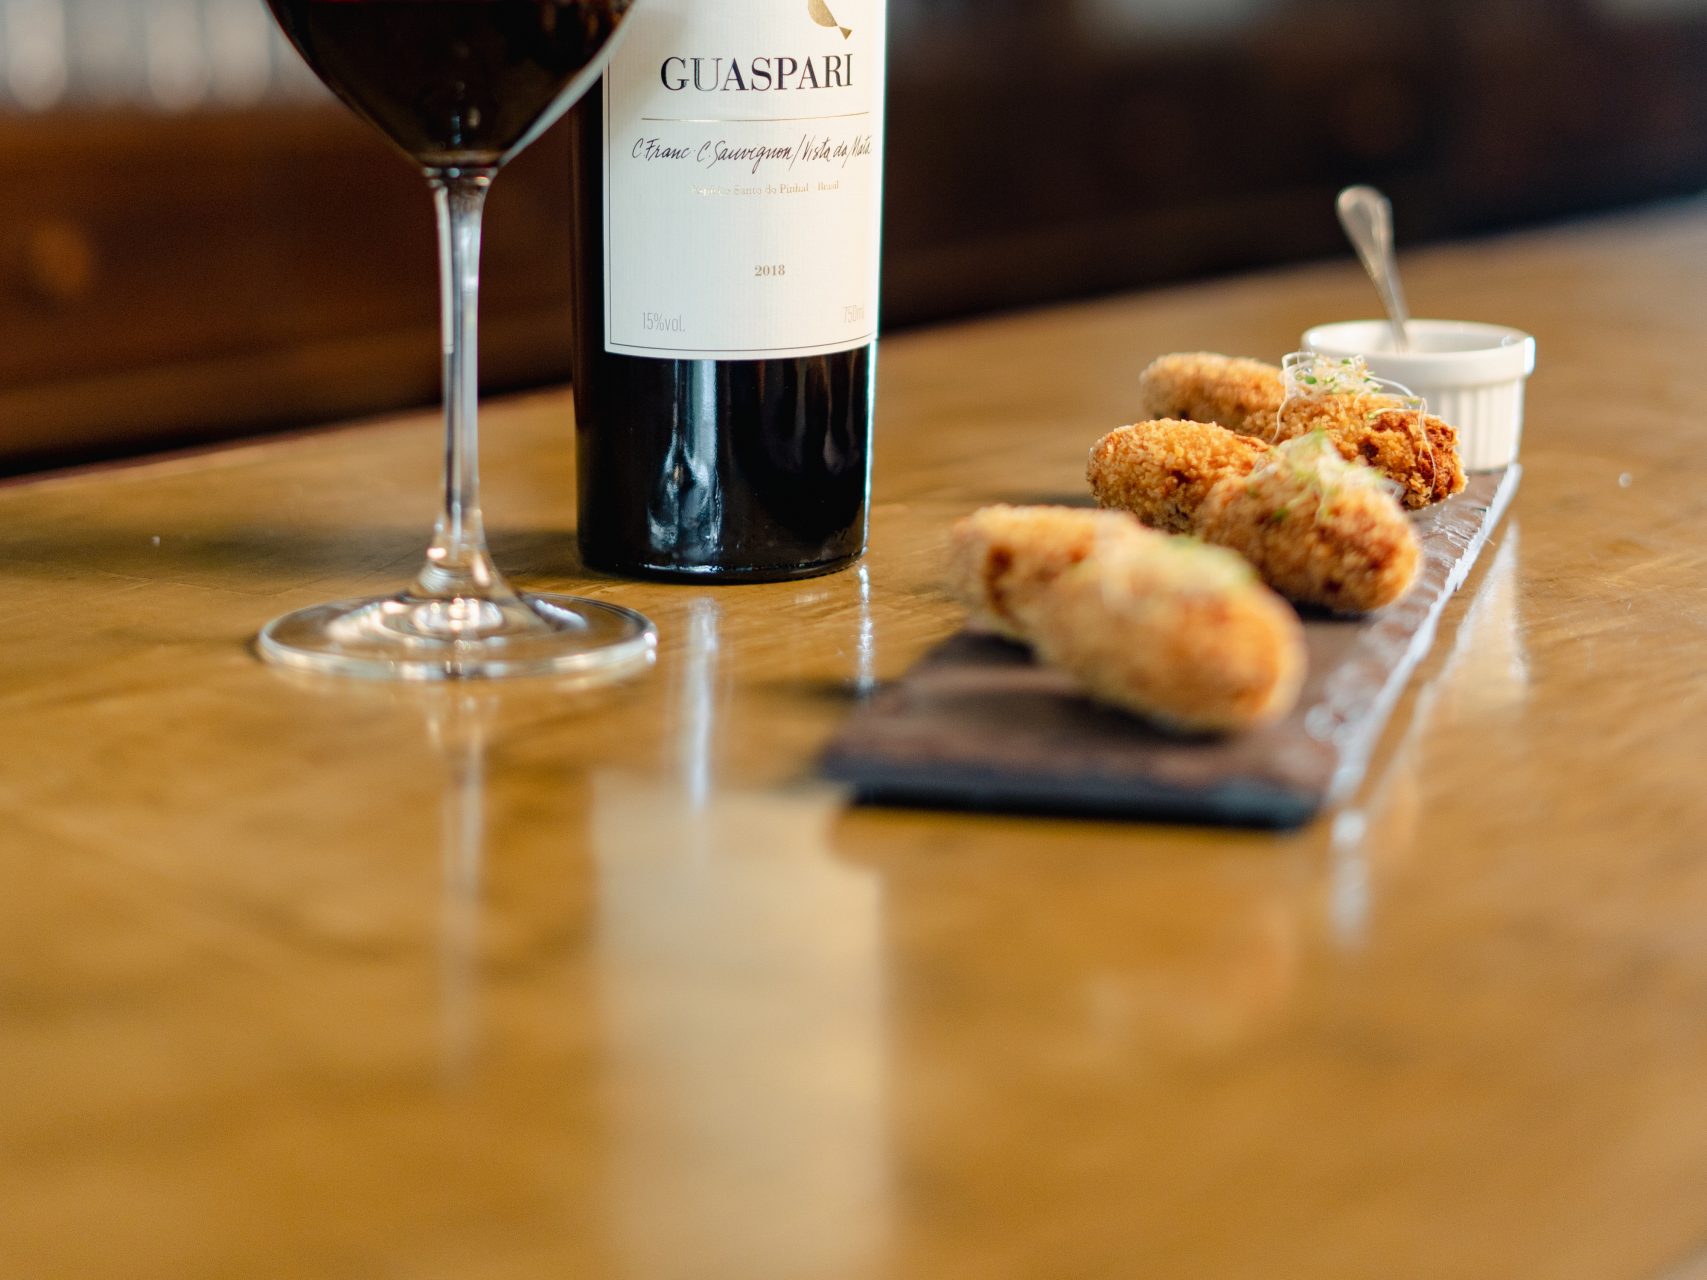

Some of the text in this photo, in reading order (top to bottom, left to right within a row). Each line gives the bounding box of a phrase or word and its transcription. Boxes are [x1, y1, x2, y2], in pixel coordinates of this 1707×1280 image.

[660, 53, 854, 91] GUASPARI
[779, 182, 809, 194] Pinhal
[754, 264, 785, 277] 2018
